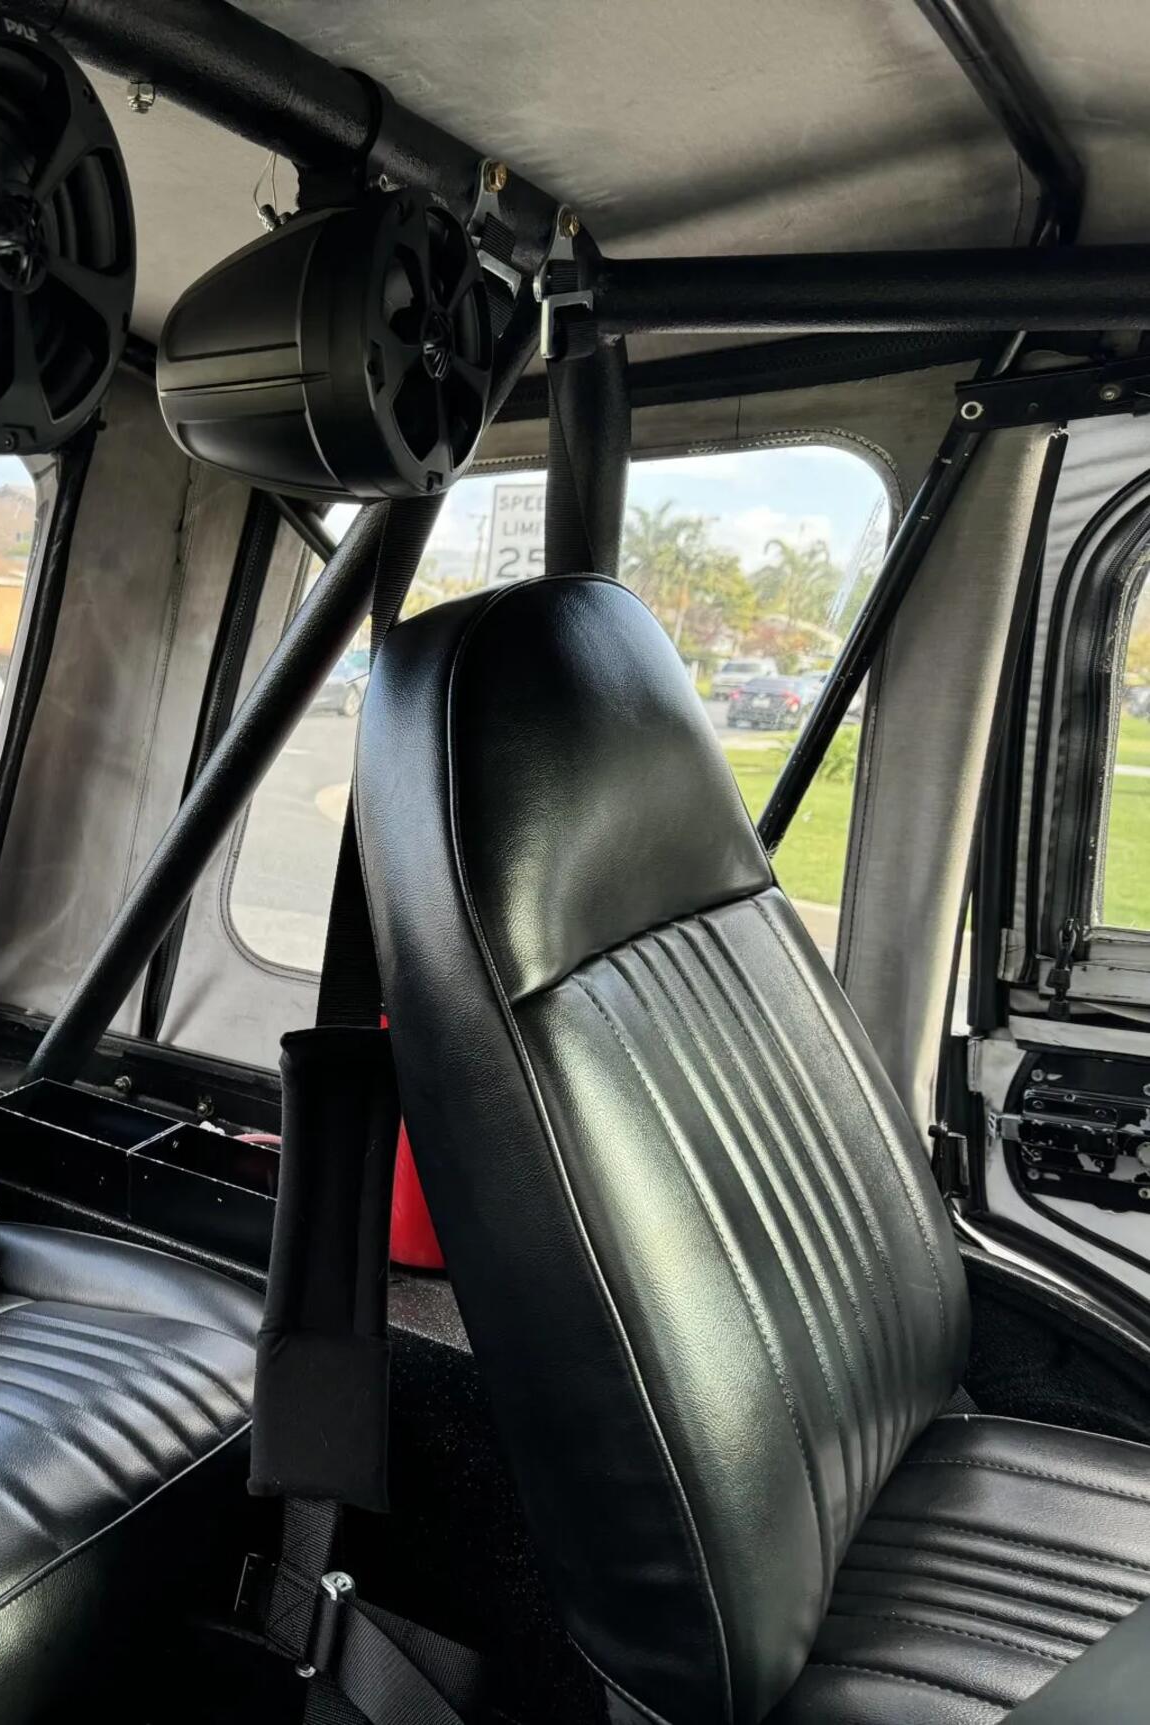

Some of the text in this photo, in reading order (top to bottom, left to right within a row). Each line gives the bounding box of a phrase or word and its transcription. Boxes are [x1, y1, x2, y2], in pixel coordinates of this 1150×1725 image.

[498, 494, 545, 511] SPEE
[503, 521, 541, 537] LIMI
[496, 547, 545, 578] 25
